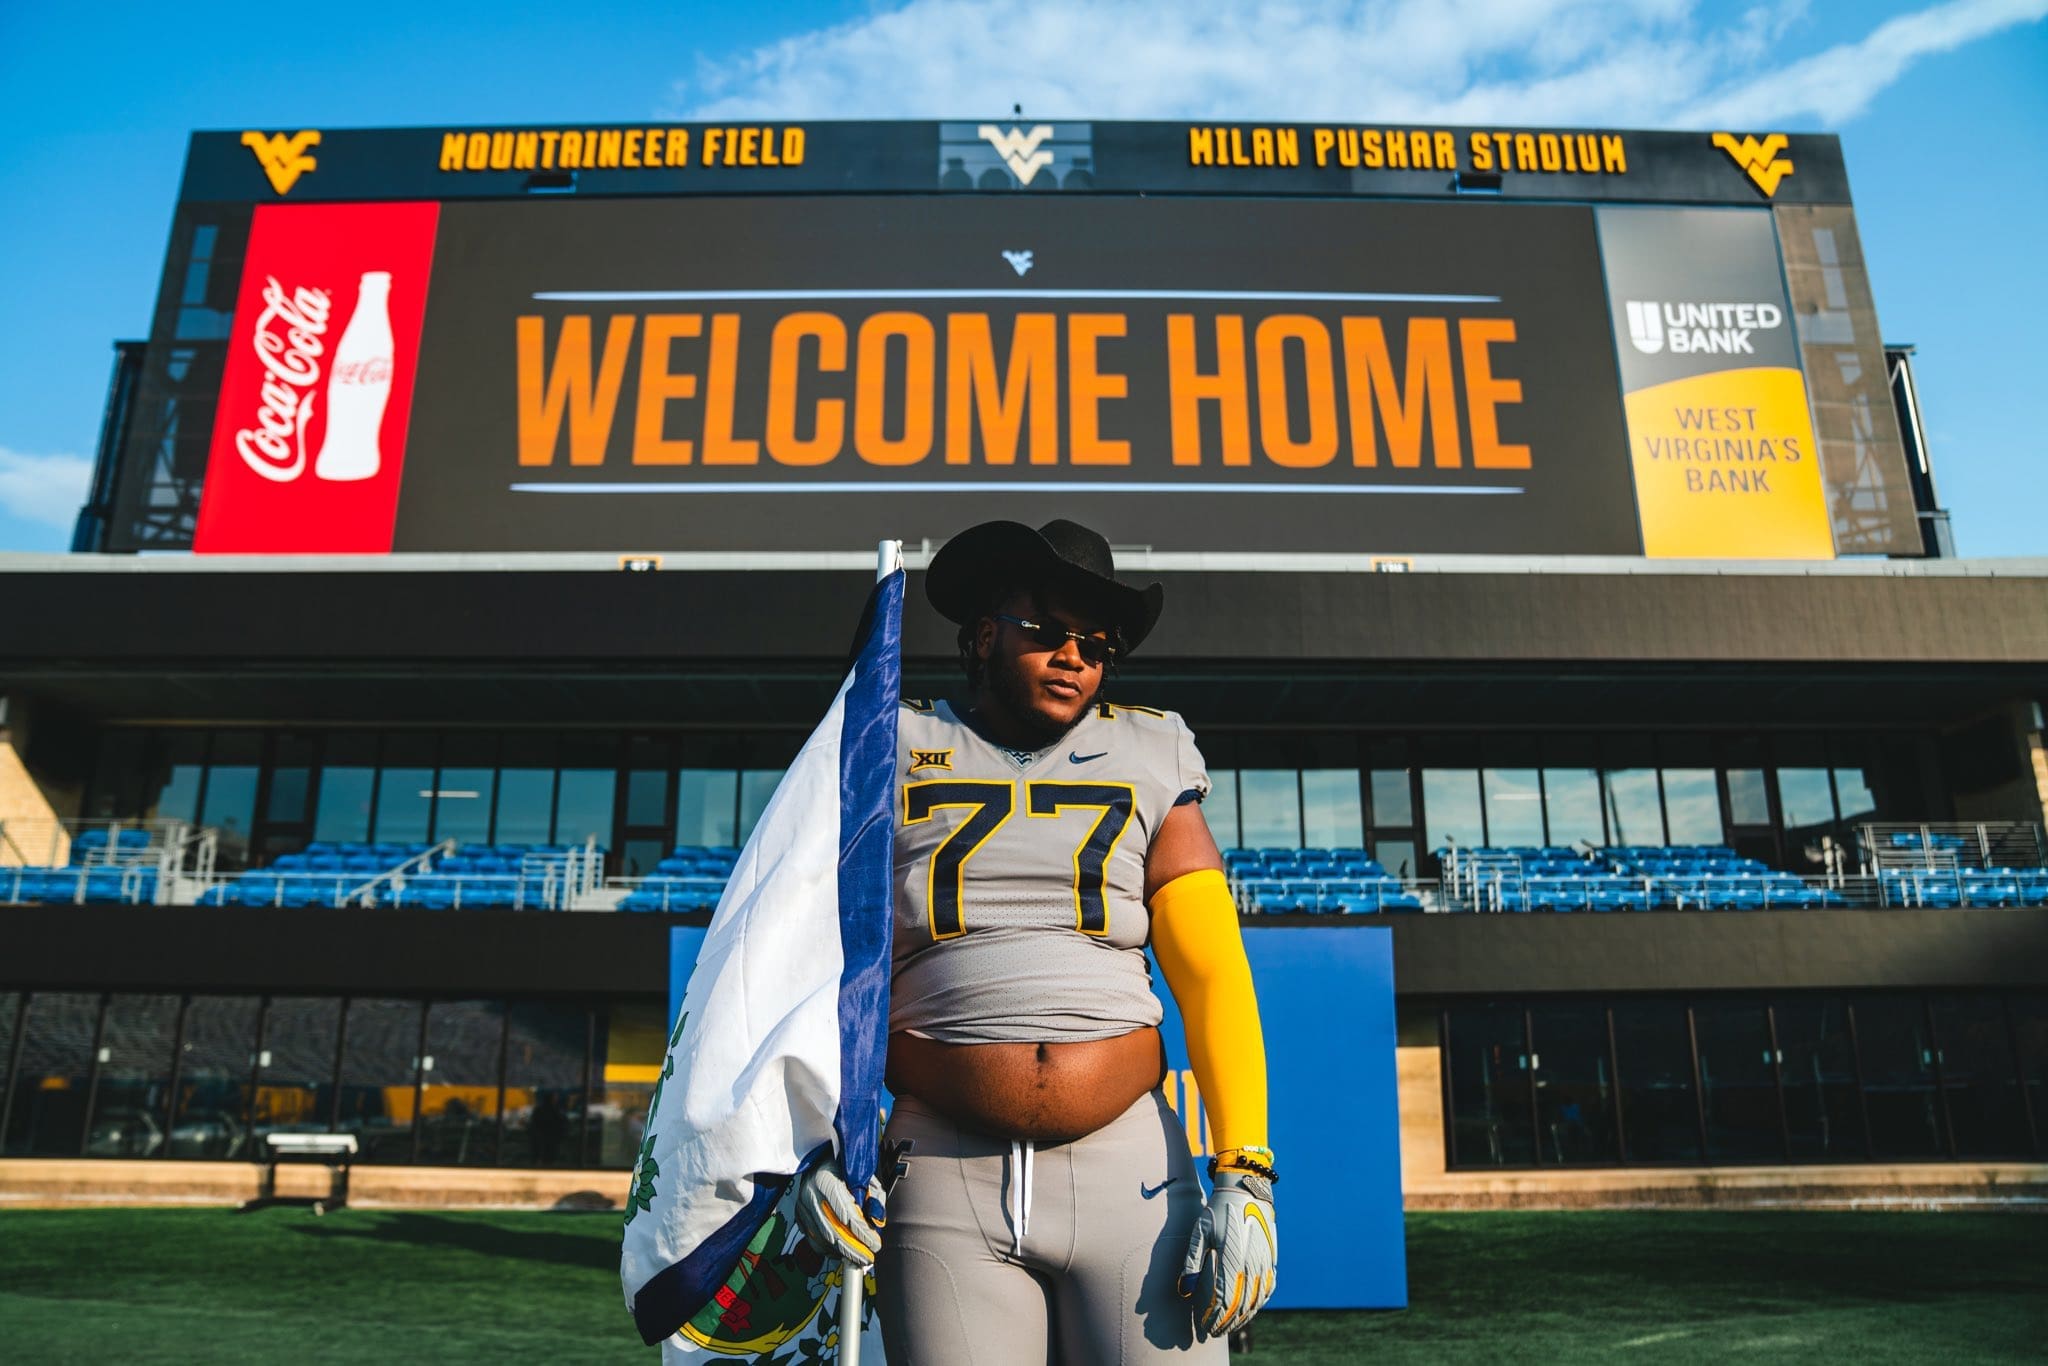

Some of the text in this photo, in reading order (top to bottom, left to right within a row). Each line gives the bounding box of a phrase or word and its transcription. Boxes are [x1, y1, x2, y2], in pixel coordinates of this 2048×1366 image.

[439, 127, 805, 171] MOUNTAINEER FIELD
[1189, 127, 1627, 173] MILAN PUSKAR STADIUM
[1664, 302, 1782, 329] UNITED
[1667, 328, 1754, 354] BANK
[517, 311, 1532, 469] WELCOME HOME
[1674, 407, 1757, 431] WEST
[1644, 436, 1801, 462] VIRGINIA'S
[1685, 468, 1771, 493] BANK
[912, 750, 953, 770] XII
[902, 777, 1138, 942] 77
